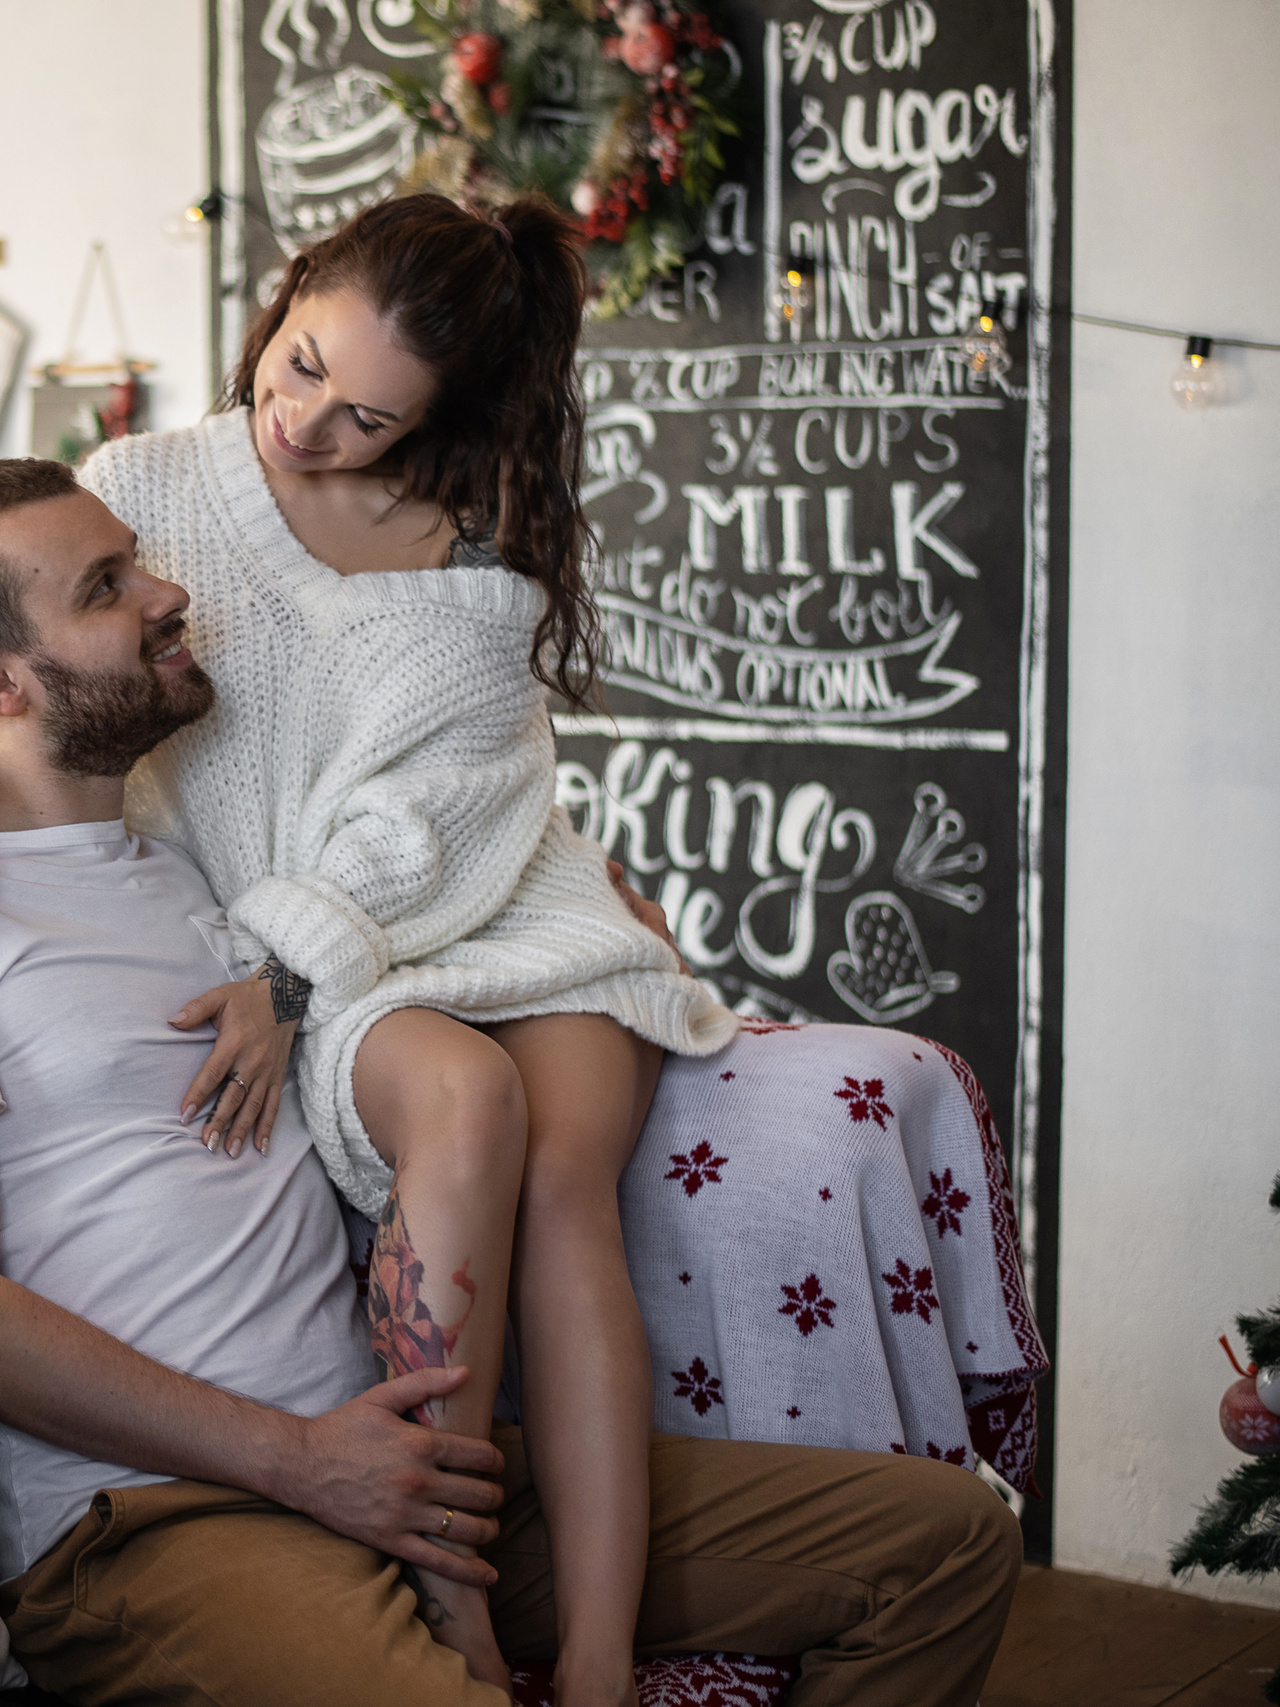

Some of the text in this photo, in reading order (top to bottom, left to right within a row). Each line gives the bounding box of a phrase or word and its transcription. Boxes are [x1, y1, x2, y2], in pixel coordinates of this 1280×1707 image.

[839, 0, 937, 75] CUP
[787, 82, 1029, 221] sugar
[789, 213, 919, 344] PINCH
[667, 352, 741, 400] CUP
[757, 350, 895, 400] BOILING
[793, 407, 960, 476] CUPS
[680, 481, 981, 581] MILK
[660, 551, 726, 626] do
[730, 574, 825, 647] not
[554, 739, 880, 980] oking
